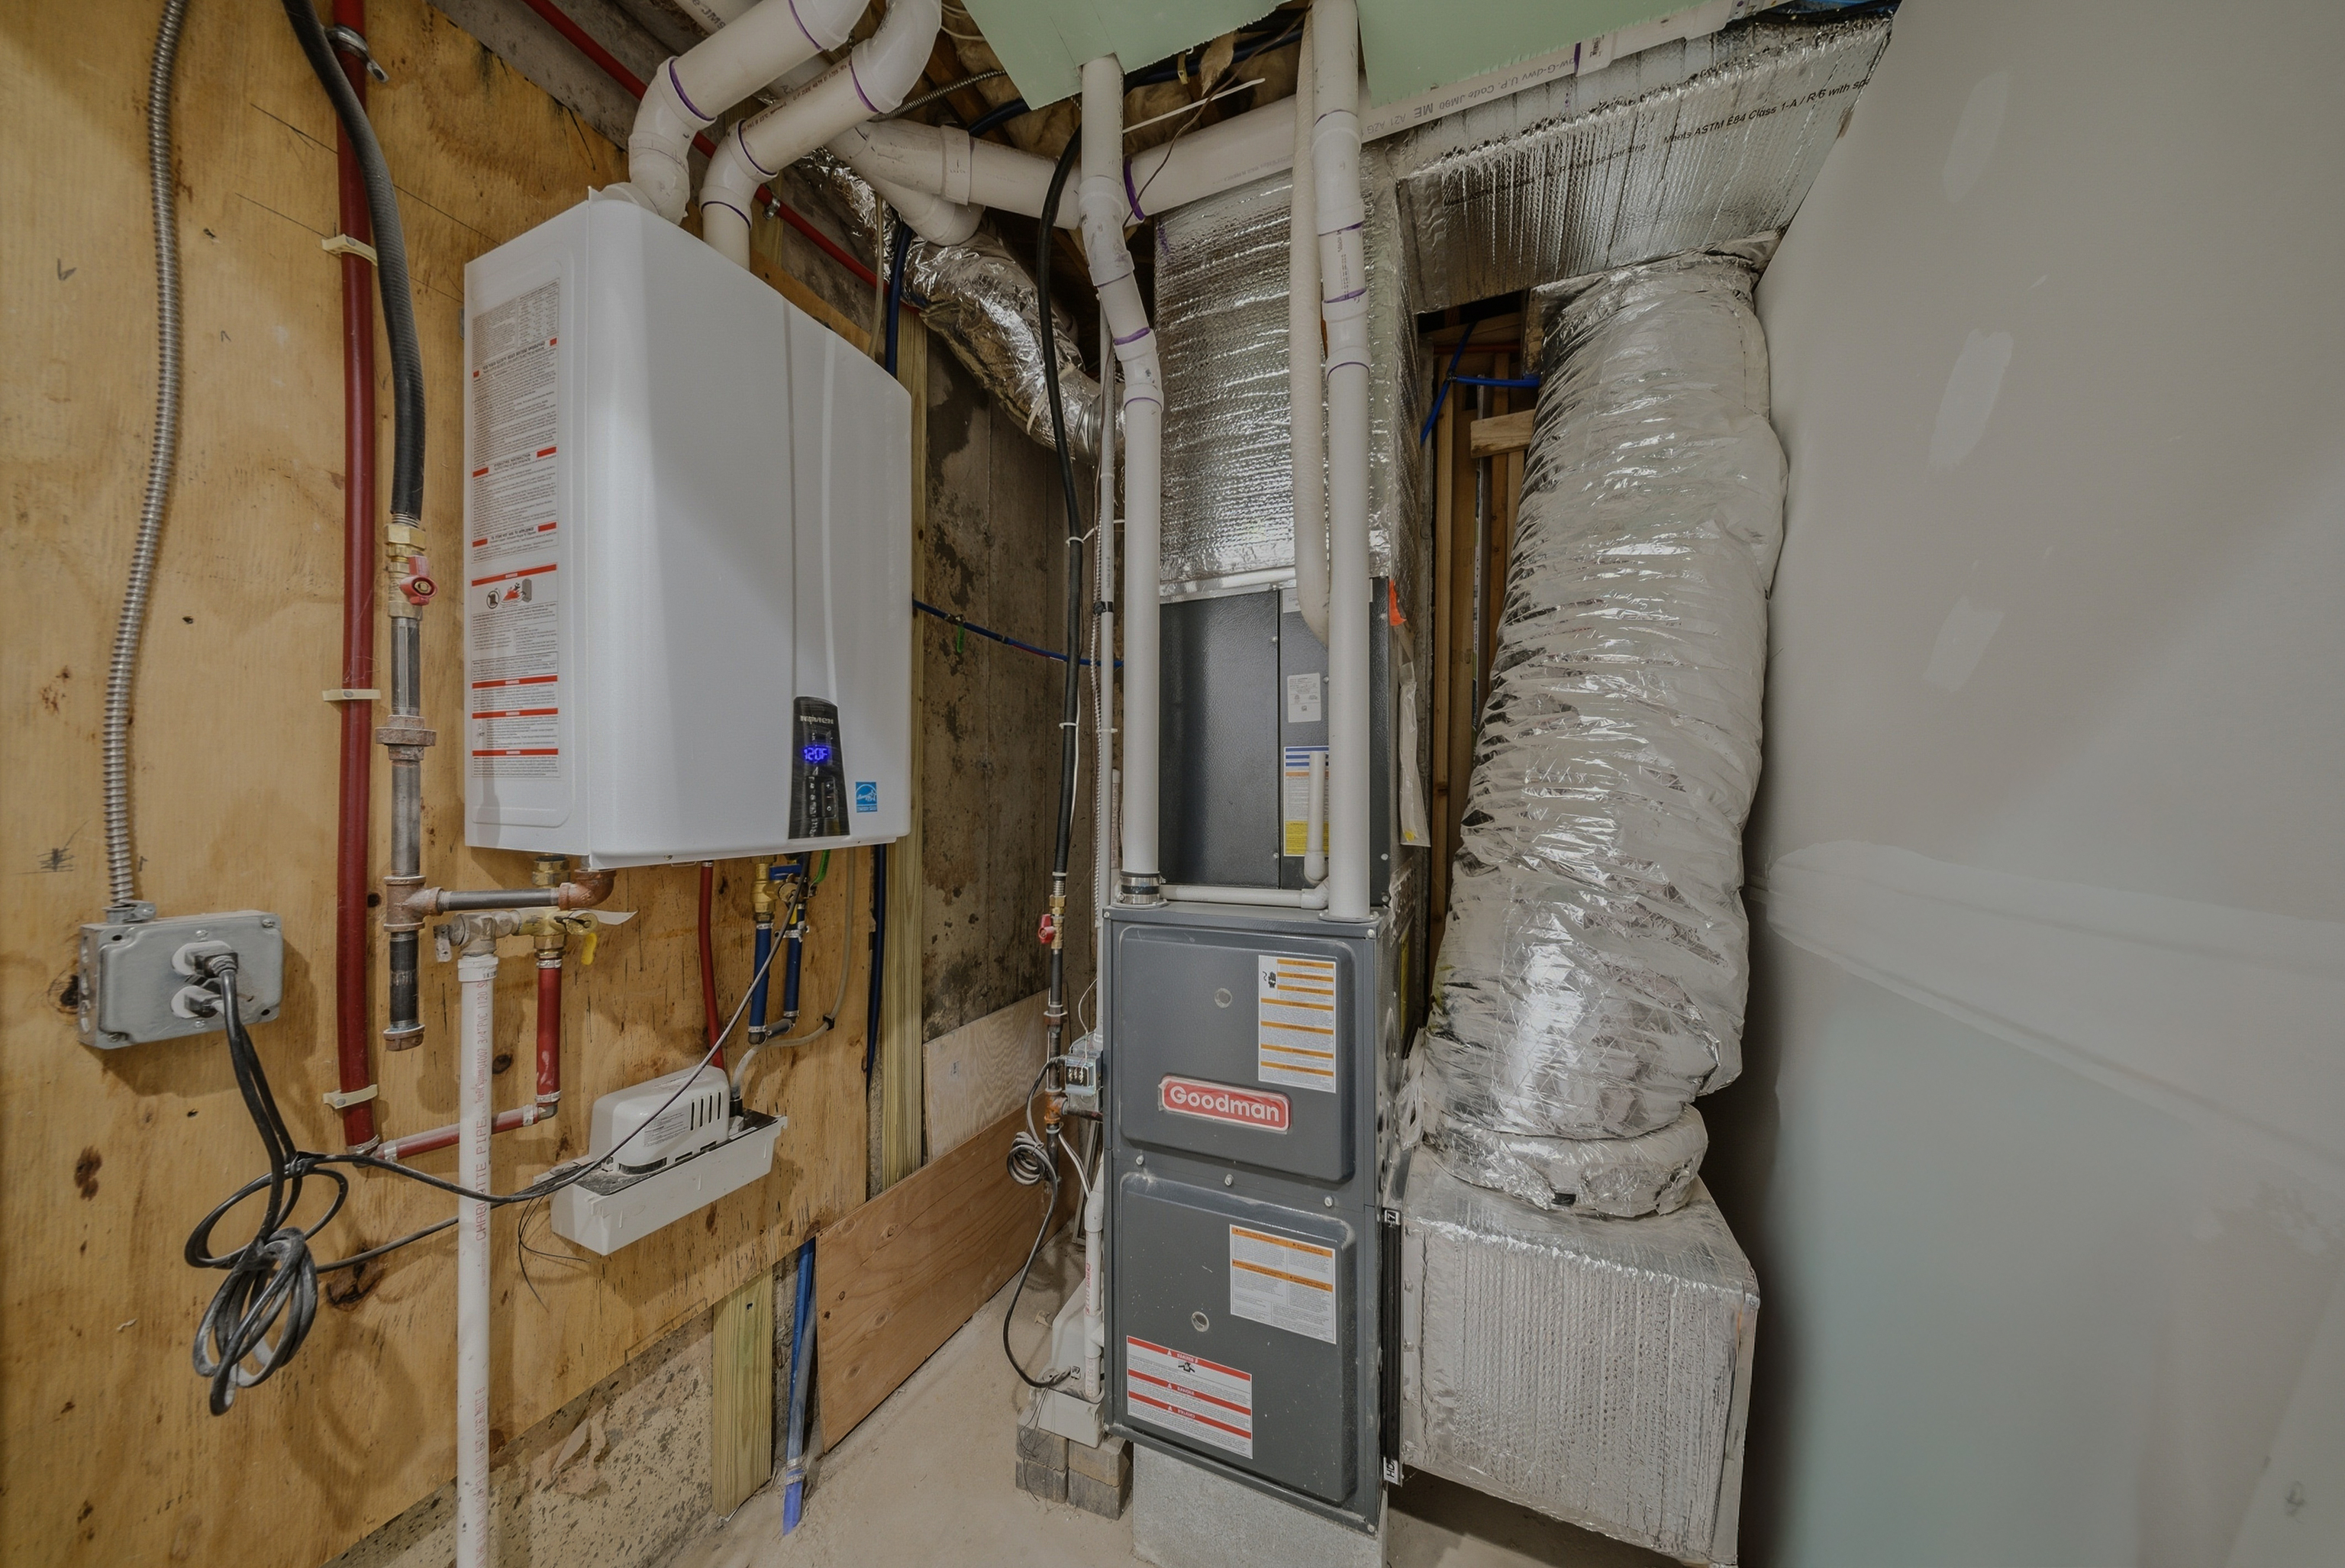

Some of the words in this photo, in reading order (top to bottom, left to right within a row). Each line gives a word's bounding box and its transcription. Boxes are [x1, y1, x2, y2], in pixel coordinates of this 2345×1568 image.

[1414, 102, 1434, 118] ME
[1694, 119, 1725, 136] ASTM
[1748, 105, 1777, 120] Class
[1827, 82, 1850, 97] with
[1169, 1086, 1279, 1122] Goodman
[476, 1119, 488, 1155] PIPE
